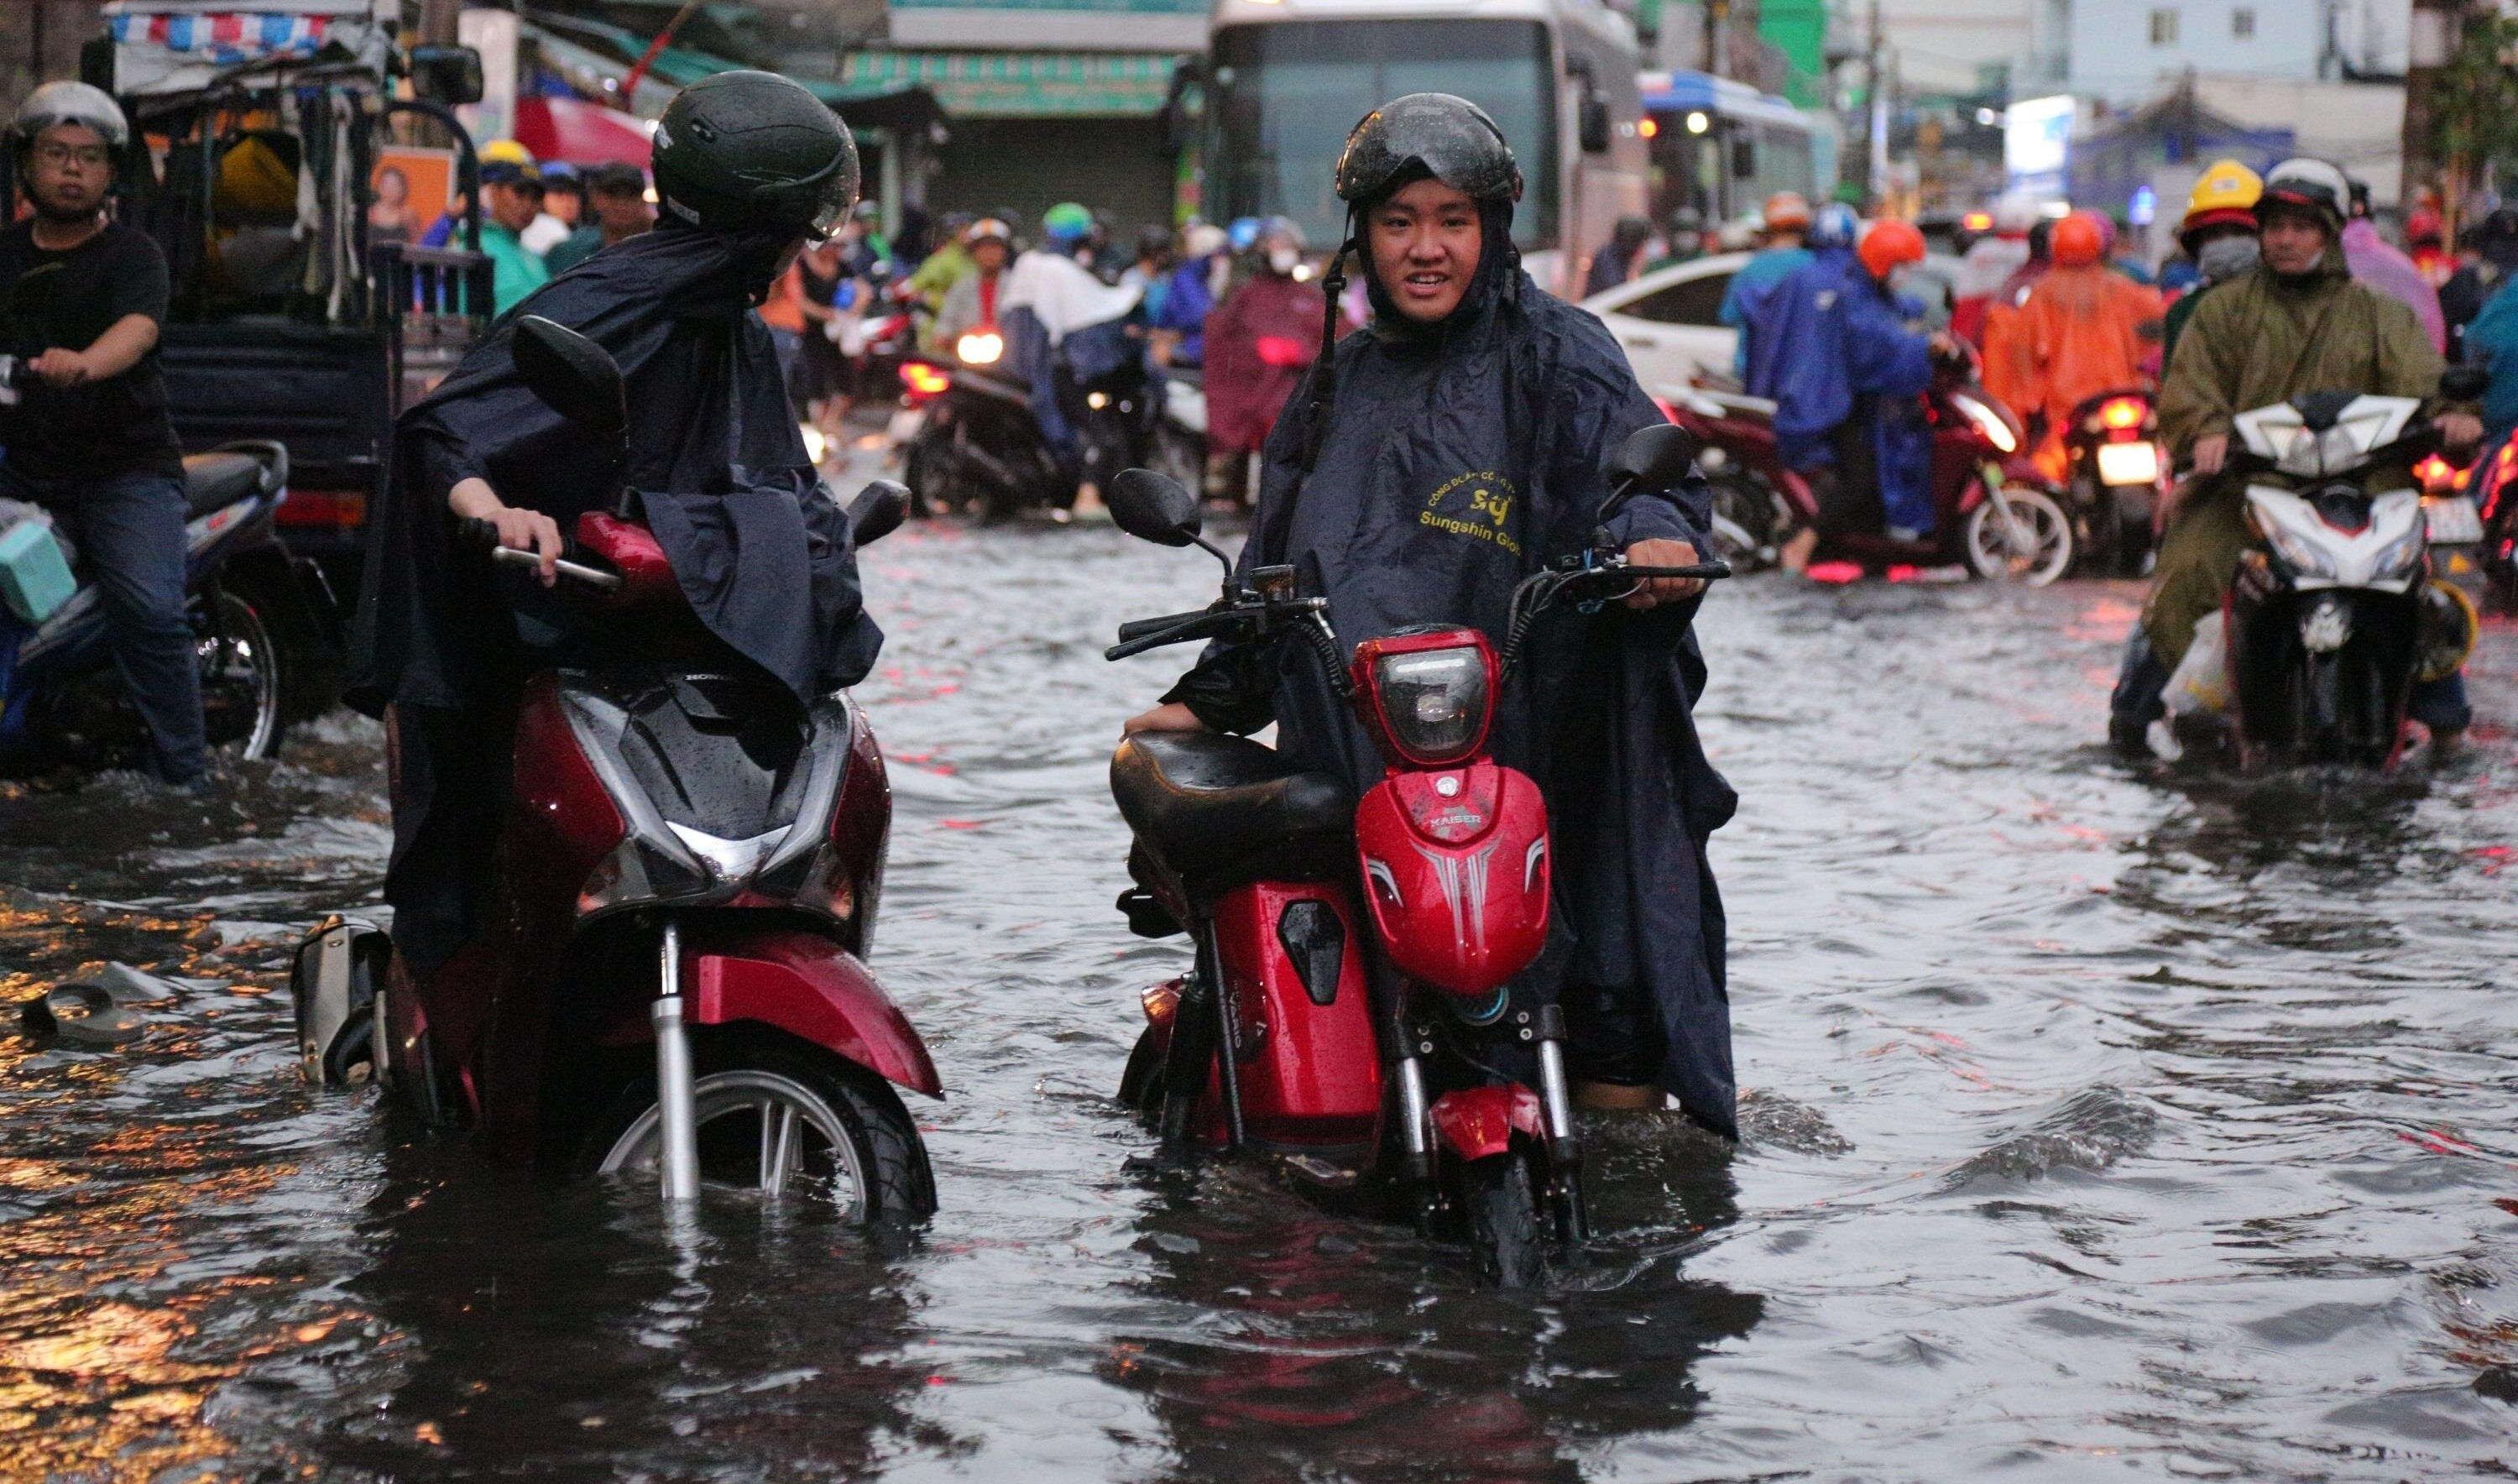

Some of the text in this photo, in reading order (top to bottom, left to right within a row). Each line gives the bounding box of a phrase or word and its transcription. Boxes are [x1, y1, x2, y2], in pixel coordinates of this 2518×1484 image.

[1419, 510, 1493, 541] Sungshin
[1429, 814, 1481, 826] KAISER
[1229, 991, 1242, 1049] VARIO
